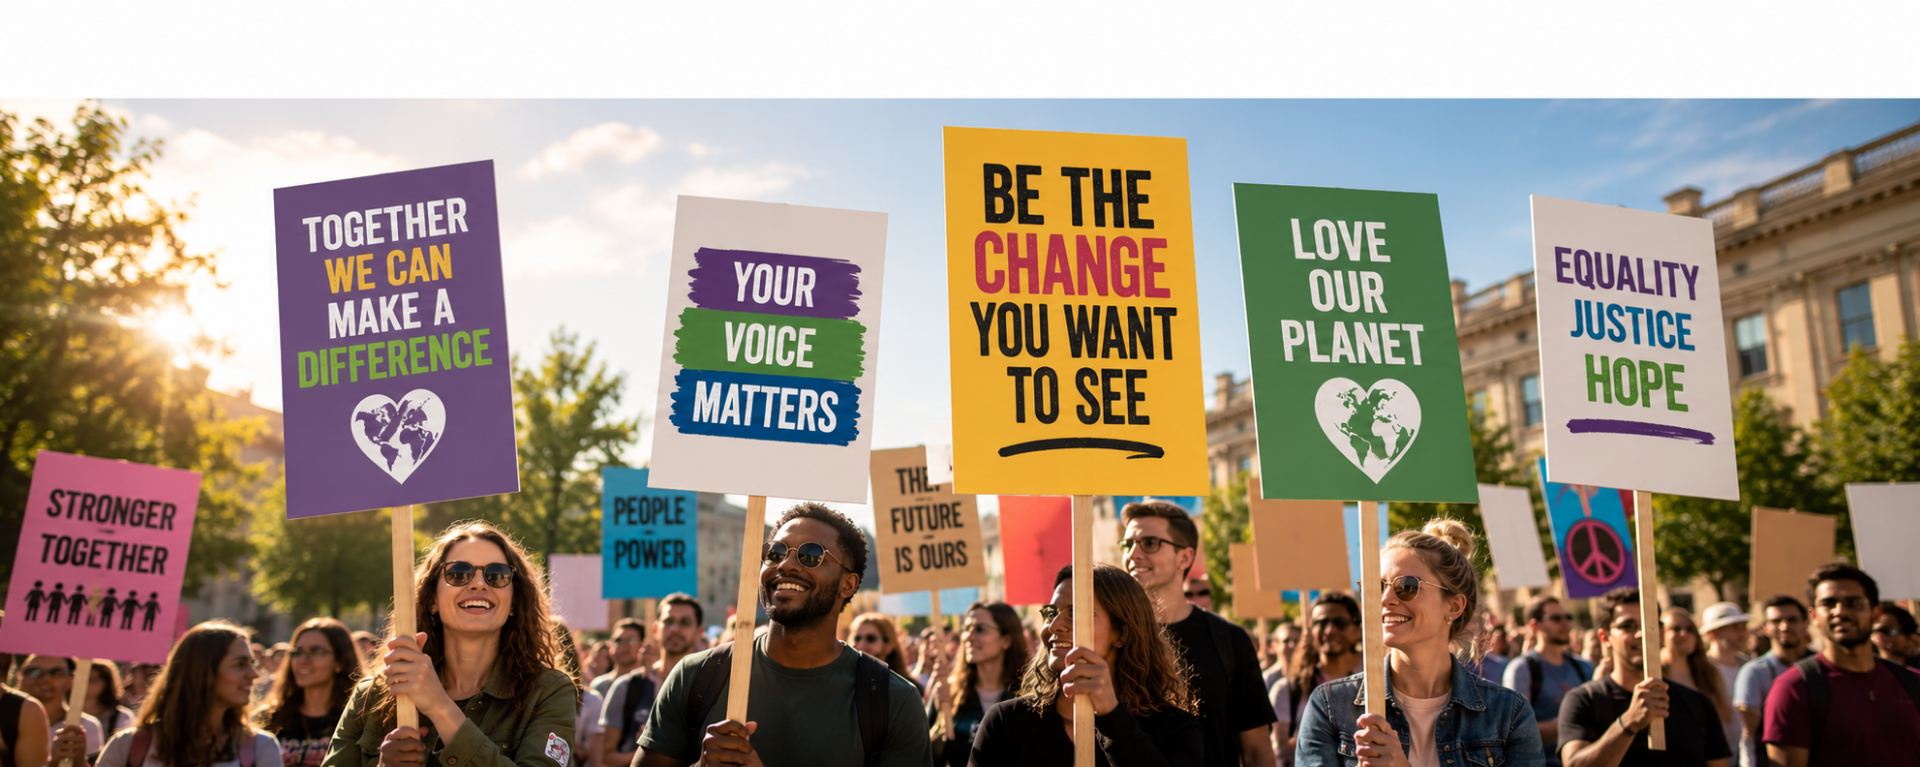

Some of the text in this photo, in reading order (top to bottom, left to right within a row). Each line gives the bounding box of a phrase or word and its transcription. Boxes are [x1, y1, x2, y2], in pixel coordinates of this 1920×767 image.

[983, 162, 1154, 229] BE THE
[303, 198, 468, 252] TOGETHER
[1291, 219, 1390, 262] LOVE
[325, 244, 452, 293] WE CAN
[734, 261, 816, 308] YOUR
[975, 231, 1170, 298] CHANGE
[1555, 246, 1699, 301] EQUALITY
[328, 288, 455, 339] MAKE A
[1309, 269, 1387, 313] OUR
[725, 322, 816, 368] VOICE
[969, 301, 1178, 361] YOU WANT
[1281, 320, 1423, 365] PLANET
[1571, 299, 1695, 351] JUSTICE
[299, 329, 492, 388] DIFFERENCE
[692, 381, 838, 433] MATTERS
[1006, 366, 1150, 426] TO SEE
[1585, 354, 1688, 412] HOPE
[895, 467, 940, 495] THE
[46, 488, 176, 531] STRONGER
[614, 496, 685, 526] PEOPLE
[891, 502, 964, 533] FUTURE
[41, 533, 168, 575] TOGETHER
[614, 539, 686, 569] POWER
[895, 540, 968, 573] IS OURS
